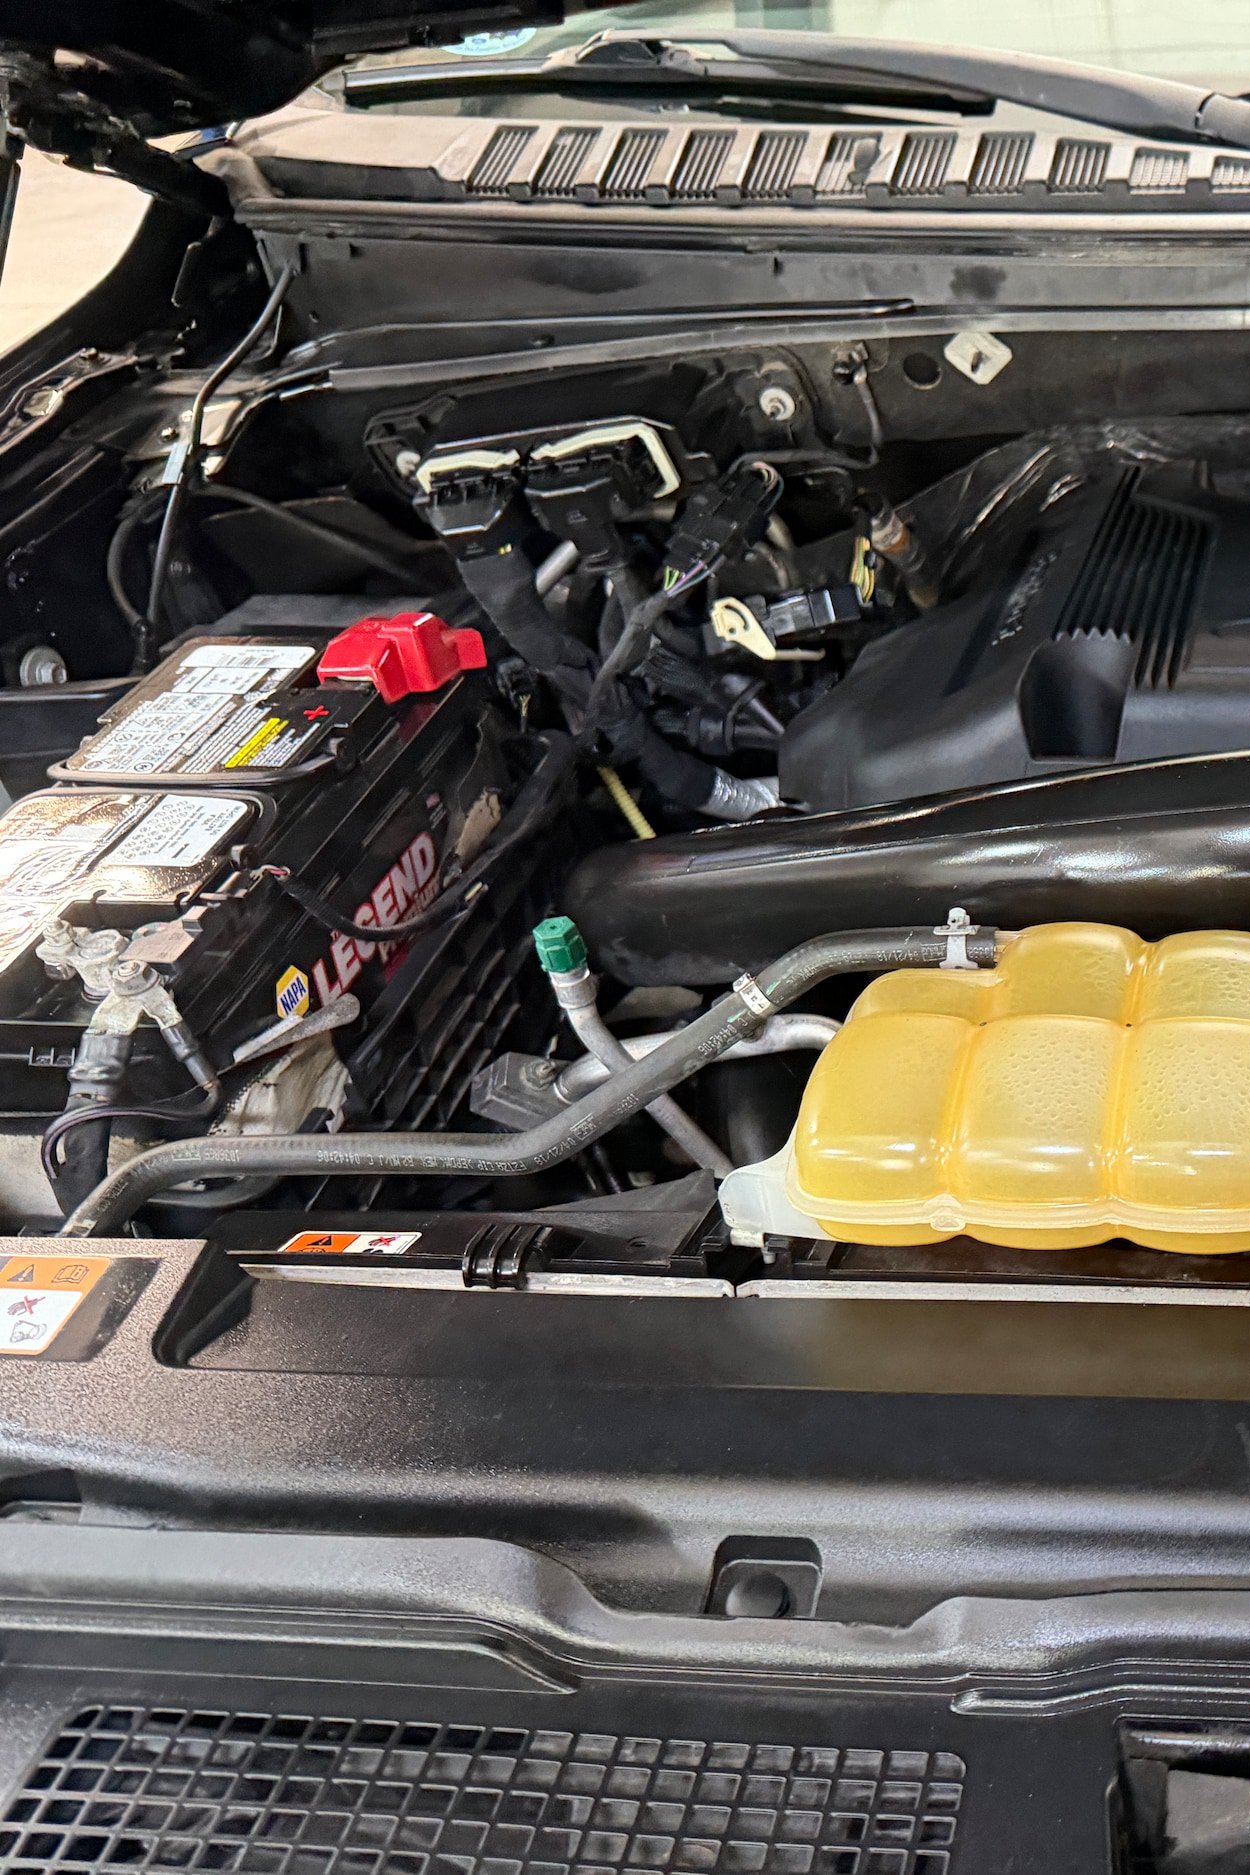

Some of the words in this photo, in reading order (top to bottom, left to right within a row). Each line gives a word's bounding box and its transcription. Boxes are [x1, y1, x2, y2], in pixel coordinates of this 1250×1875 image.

[312, 831, 435, 1008] LEGEND
[280, 975, 307, 1016] NAPA
[698, 1023, 738, 1056] 04:42:06
[317, 1150, 361, 1164] 04:42:06
[533, 1136, 578, 1166] 04/21/18
